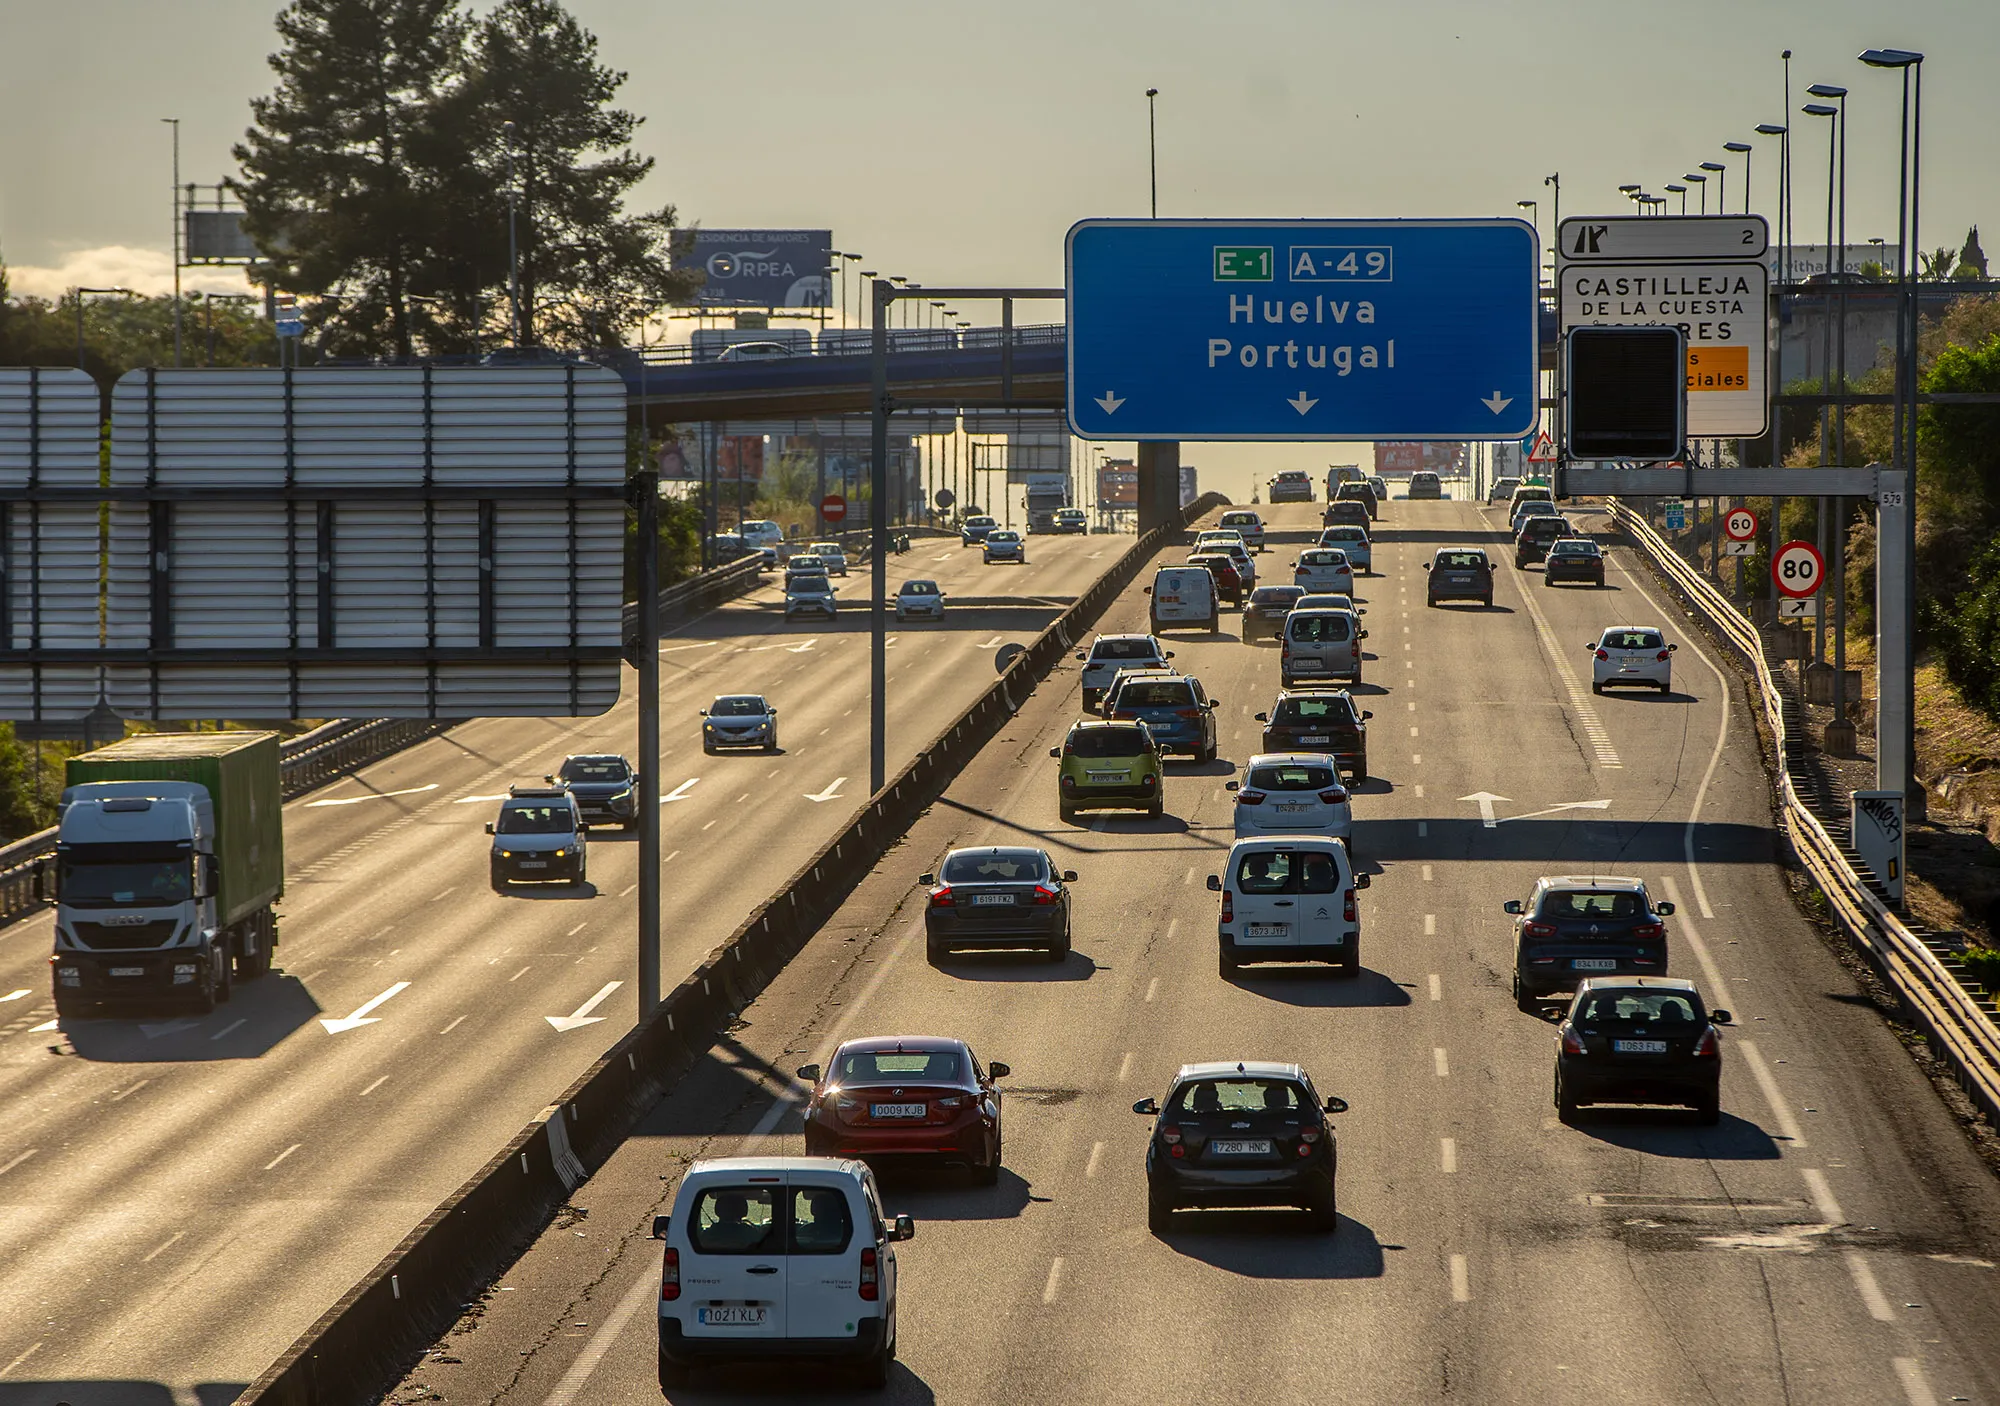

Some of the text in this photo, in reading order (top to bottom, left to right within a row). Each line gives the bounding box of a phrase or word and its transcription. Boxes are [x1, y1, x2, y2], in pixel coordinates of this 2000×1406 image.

[752, 233, 765, 243] DE
[767, 233, 810, 243] MAYORES
[1741, 229, 1754, 245] 2
[706, 249, 796, 279] ORPEA
[1218, 252, 1268, 276] E-1
[1294, 251, 1385, 276] A-49
[1575, 276, 1750, 296] CASTILLEJA
[1229, 294, 1375, 324] Huelva
[1582, 300, 1744, 316] DE LA CUESTA
[1208, 338, 1395, 377] Portugal
[1686, 372, 1745, 386] ciales
[1731, 518, 1751, 530] 60
[1783, 559, 1813, 579] 80
[979, 895, 996, 903] 6191
[1249, 927, 1269, 936] 3673
[1621, 1041, 1644, 1051] 1063
[877, 1105, 923, 1115] 0009 KJB
[1219, 1142, 1267, 1153] 7280 HNC
[709, 1309, 764, 1322] 1021 KLX
